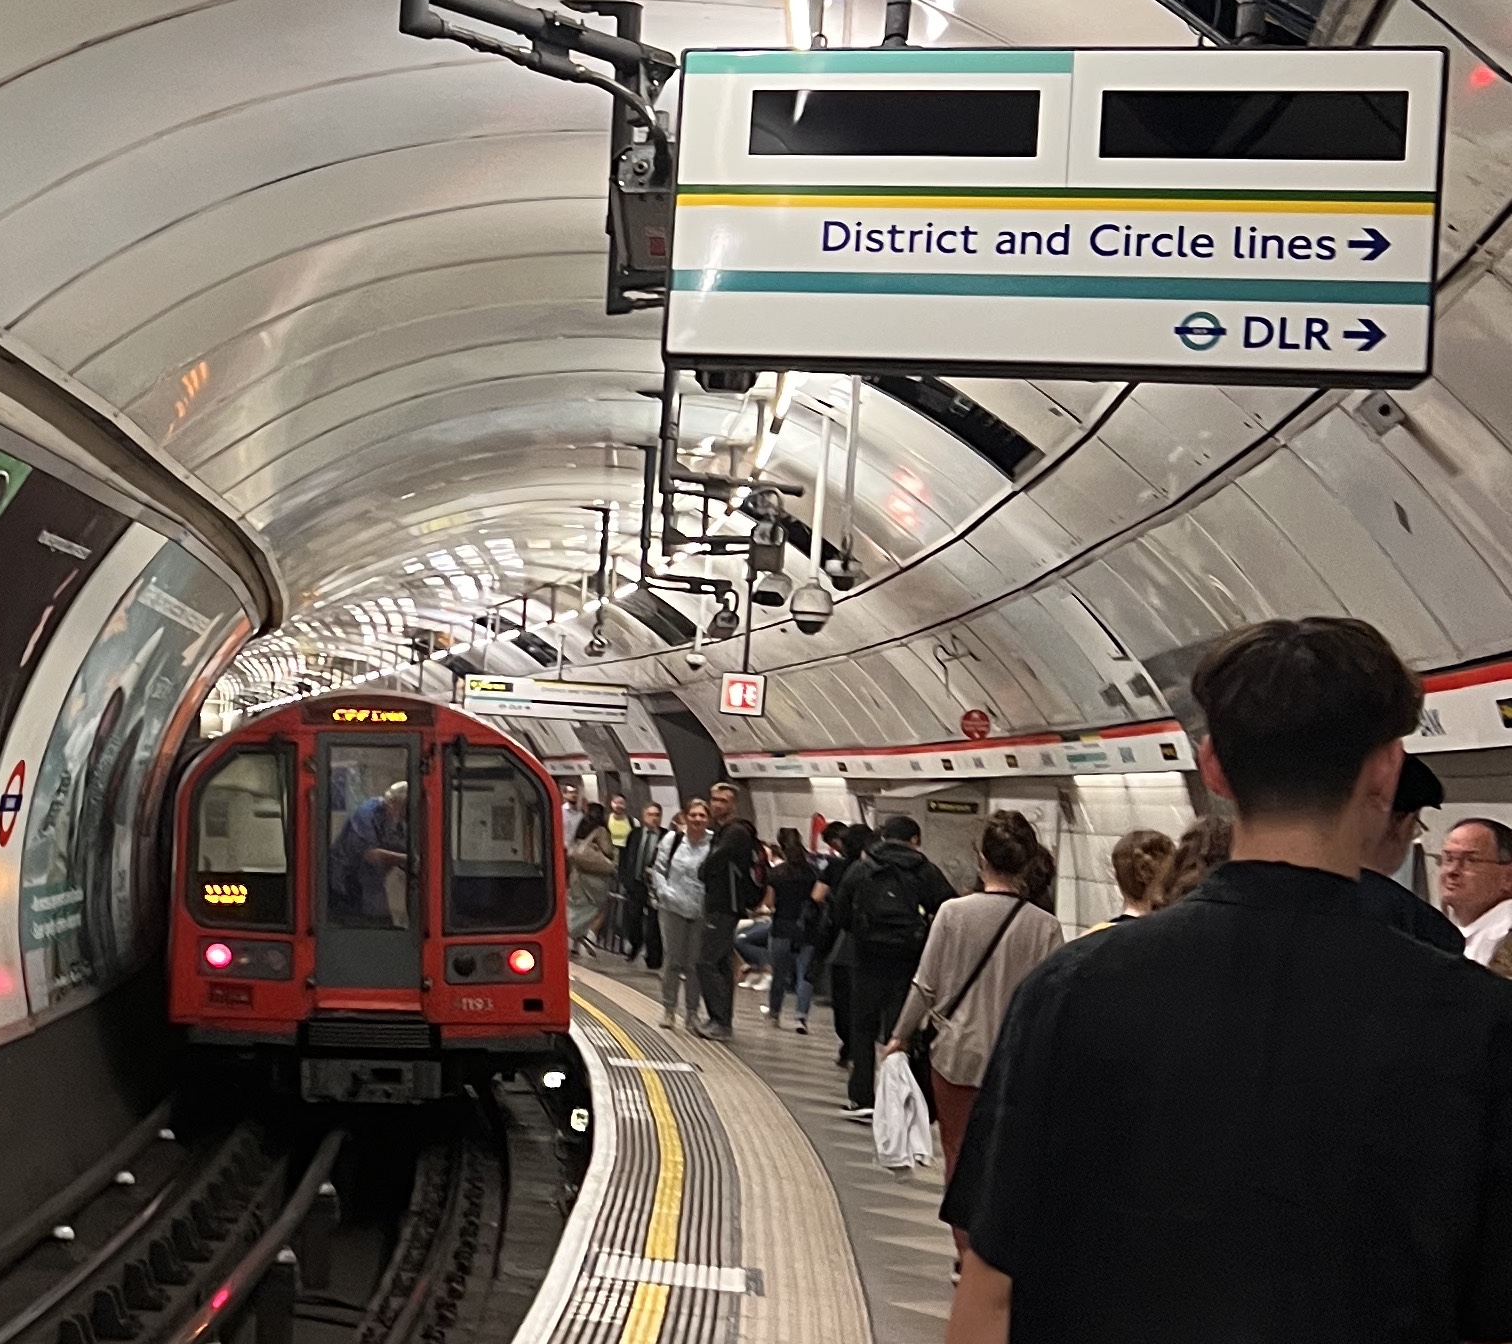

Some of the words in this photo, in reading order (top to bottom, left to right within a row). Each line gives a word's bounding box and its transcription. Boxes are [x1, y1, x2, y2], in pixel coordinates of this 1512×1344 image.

[821, 220, 978, 255] District
[996, 223, 1070, 256] and
[1090, 224, 1215, 259] Circle
[1234, 226, 1337, 260] lines
[1243, 316, 1332, 350] DLR
